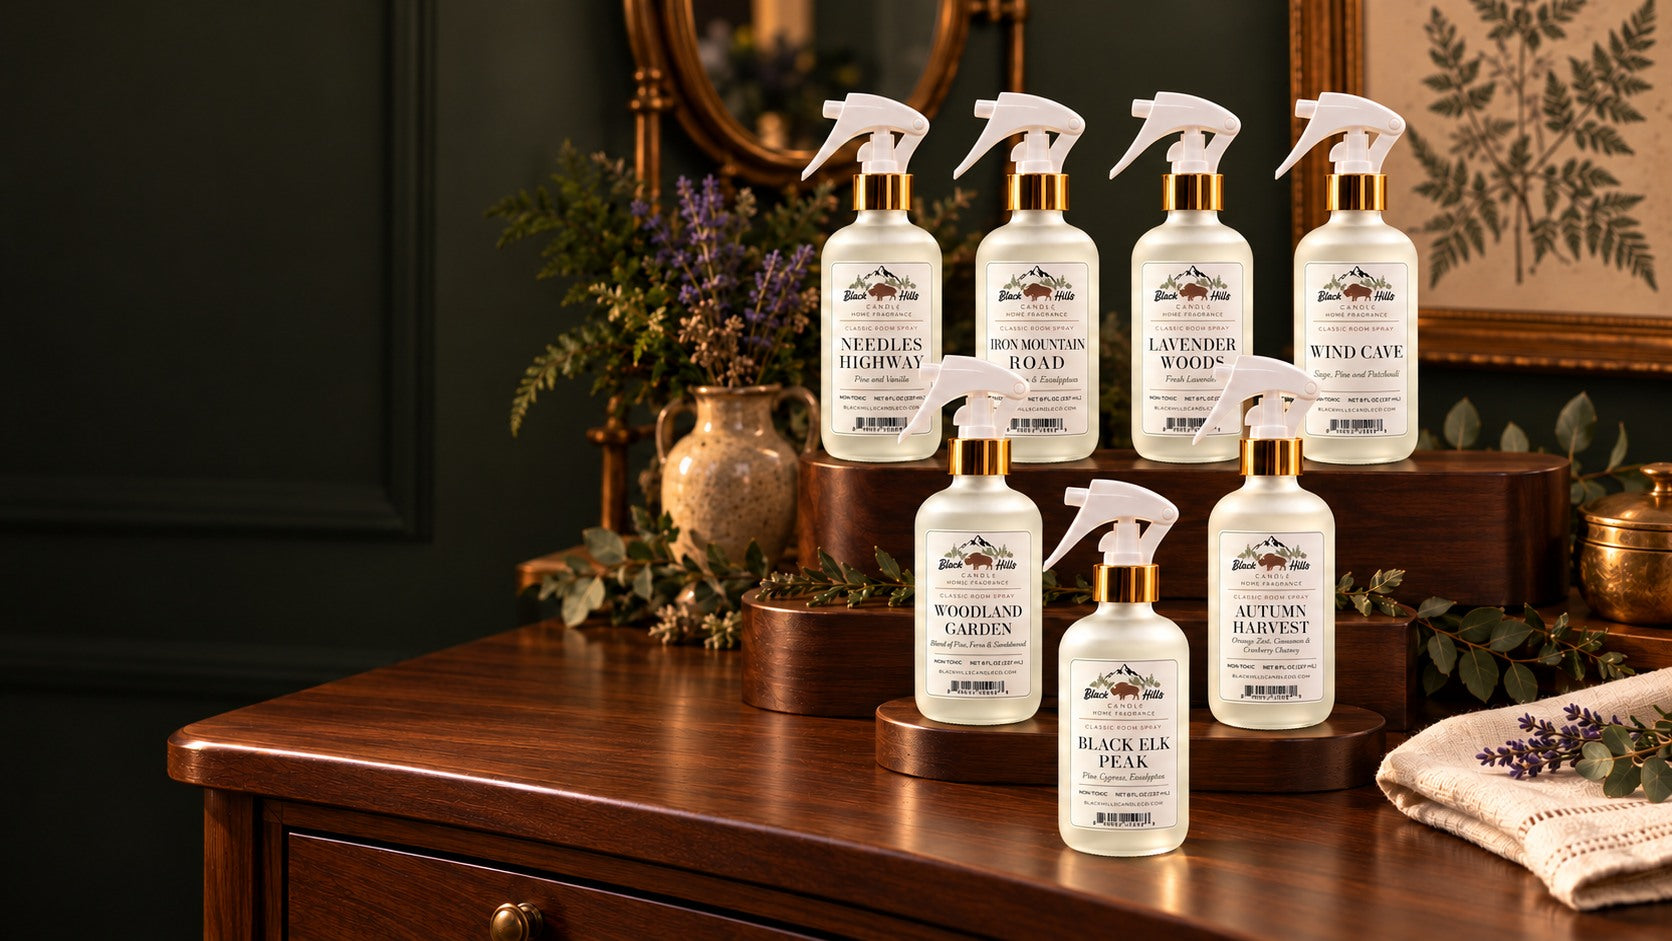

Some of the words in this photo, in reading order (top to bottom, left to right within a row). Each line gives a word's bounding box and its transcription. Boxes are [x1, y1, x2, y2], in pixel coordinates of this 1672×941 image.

[843, 290, 867, 301] Black
[899, 290, 919, 300] Hills
[999, 290, 1022, 302] Black
[1055, 290, 1075, 300] Hills
[1154, 290, 1178, 302] Black
[1210, 290, 1231, 300] Hills
[1318, 290, 1341, 302] Black
[1374, 291, 1395, 301] Hills
[841, 338, 922, 351] NEEDLES
[991, 338, 1018, 350] IRON
[1021, 338, 1084, 350] MOUNTAIN
[1149, 338, 1236, 351] LAVENDER
[1311, 345, 1356, 358] WIND
[1361, 345, 1403, 359] CAVE
[840, 355, 924, 369] HIGHWAY
[1010, 356, 1064, 369] ROAD
[1160, 356, 1224, 369] WOODS
[1314, 370, 1333, 379] Sage,
[938, 559, 963, 570] Black
[996, 559, 1017, 570] Hills
[1232, 560, 1256, 571] Black
[1289, 560, 1310, 570] Hills
[935, 604, 1022, 618] WOODLAND
[1236, 604, 1306, 618] AUTUMN
[945, 622, 1012, 636] GARDEN
[1233, 621, 1309, 634] HARVEST
[948, 641, 953, 649] of
[1084, 688, 1108, 700] Black
[1142, 689, 1164, 700] Hills
[1079, 736, 1133, 751] BLACK
[1140, 736, 1170, 751] ELK
[1099, 755, 1148, 768] PEAK
